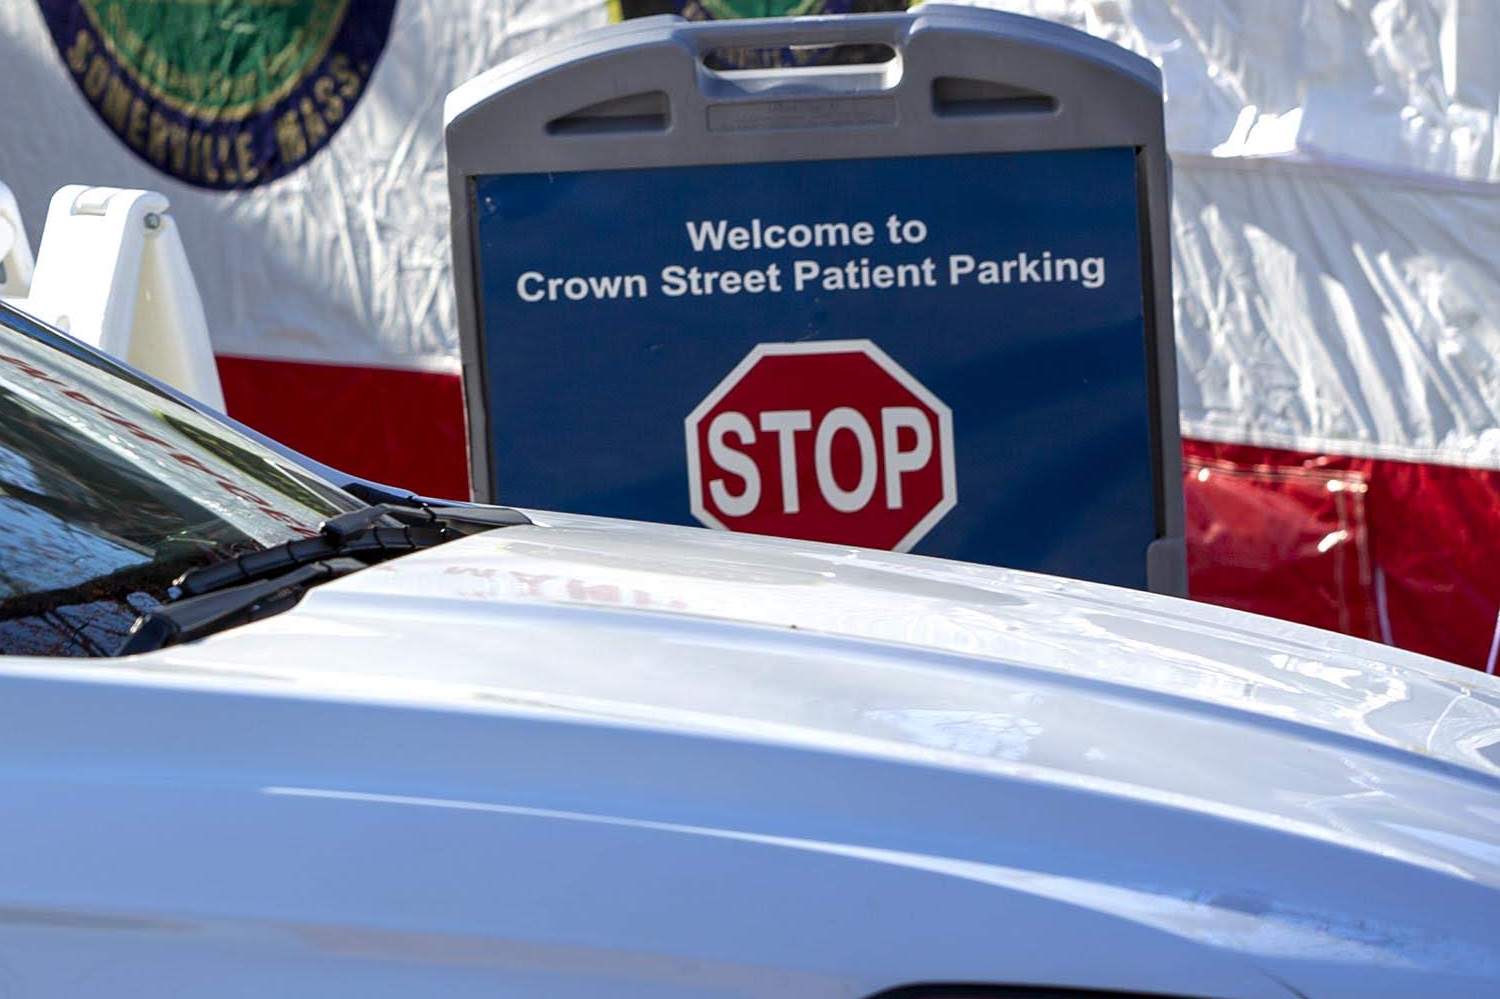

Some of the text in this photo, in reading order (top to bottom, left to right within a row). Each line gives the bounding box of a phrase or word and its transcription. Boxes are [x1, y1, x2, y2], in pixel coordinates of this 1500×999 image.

[67, 29, 260, 184] SOMERVILLE
[686, 214, 928, 252] Welcome to
[516, 251, 1106, 303] Crown Street Patient Parking
[707, 406, 934, 518] STOP
